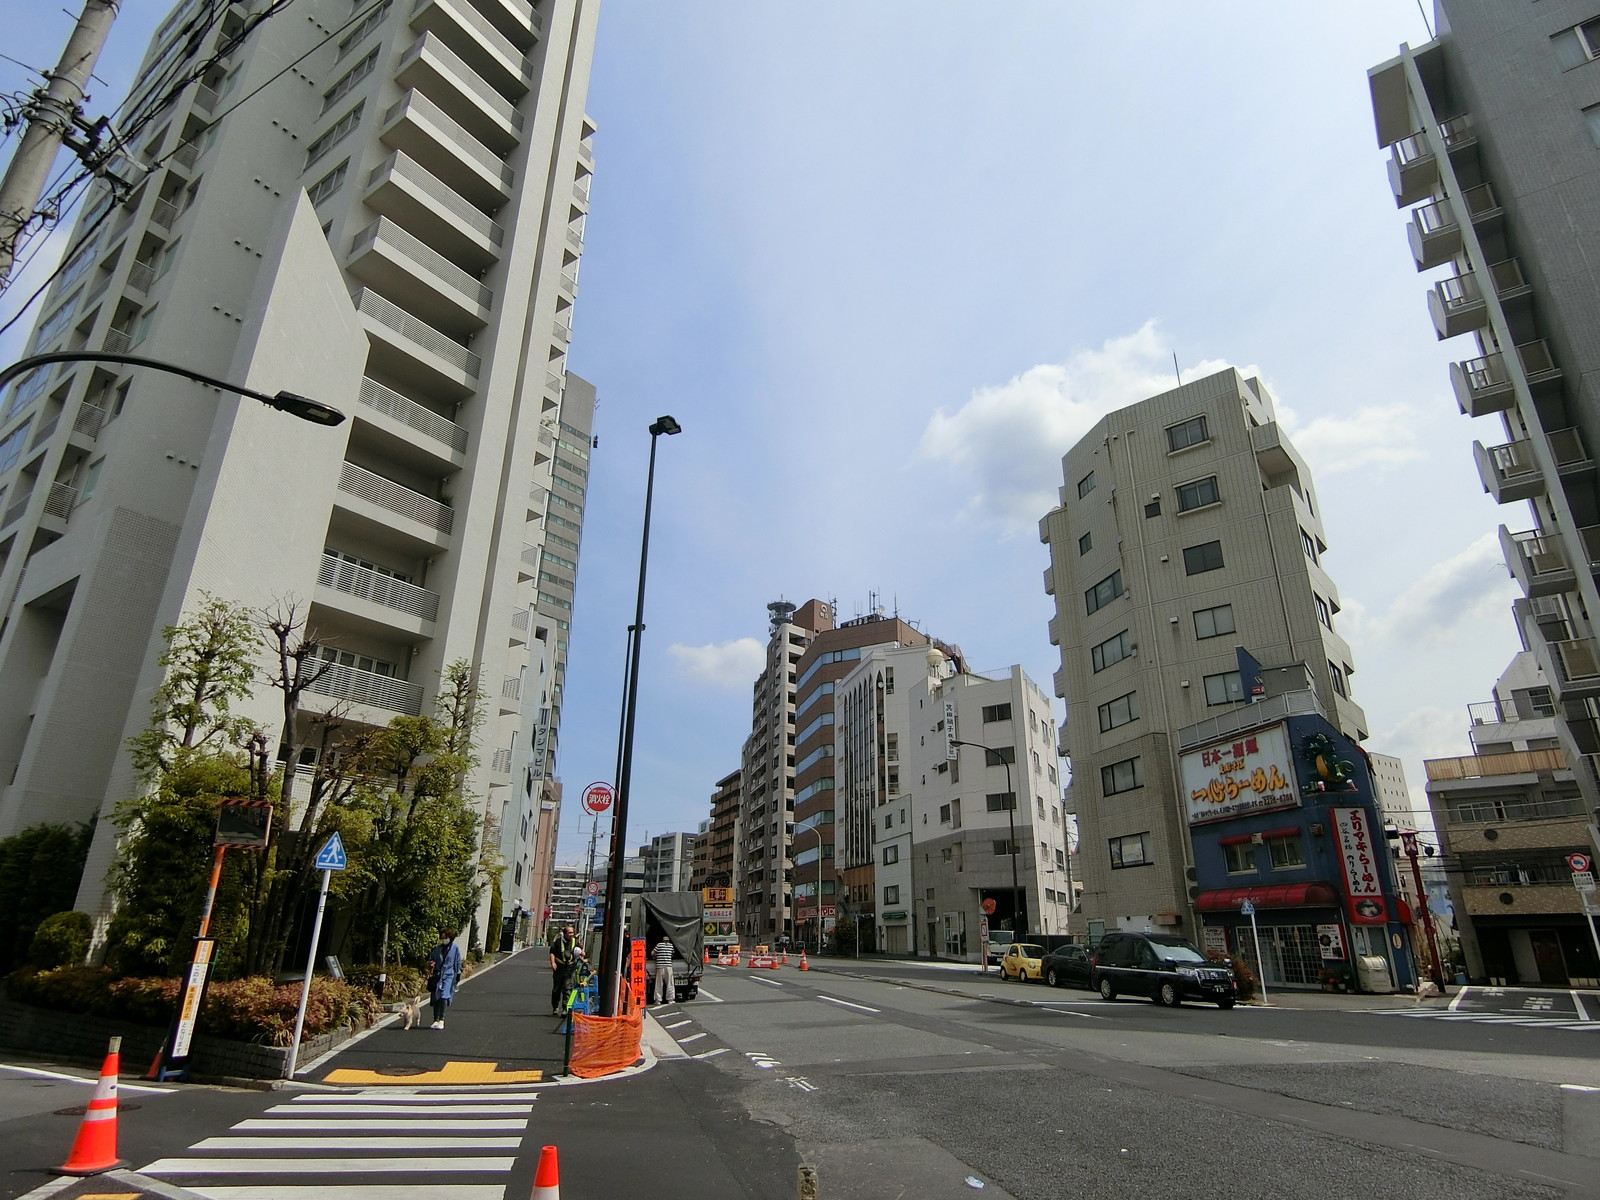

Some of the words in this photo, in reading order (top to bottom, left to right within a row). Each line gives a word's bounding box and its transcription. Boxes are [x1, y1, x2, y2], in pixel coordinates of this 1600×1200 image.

[588, 793, 611, 805] 消火栓
[1349, 809, 1377, 893] エリマキらーめん
[1346, 854, 1362, 893] のりらーめん
[709, 888, 725, 900] 工事中
[633, 949, 643, 987] 工事中
